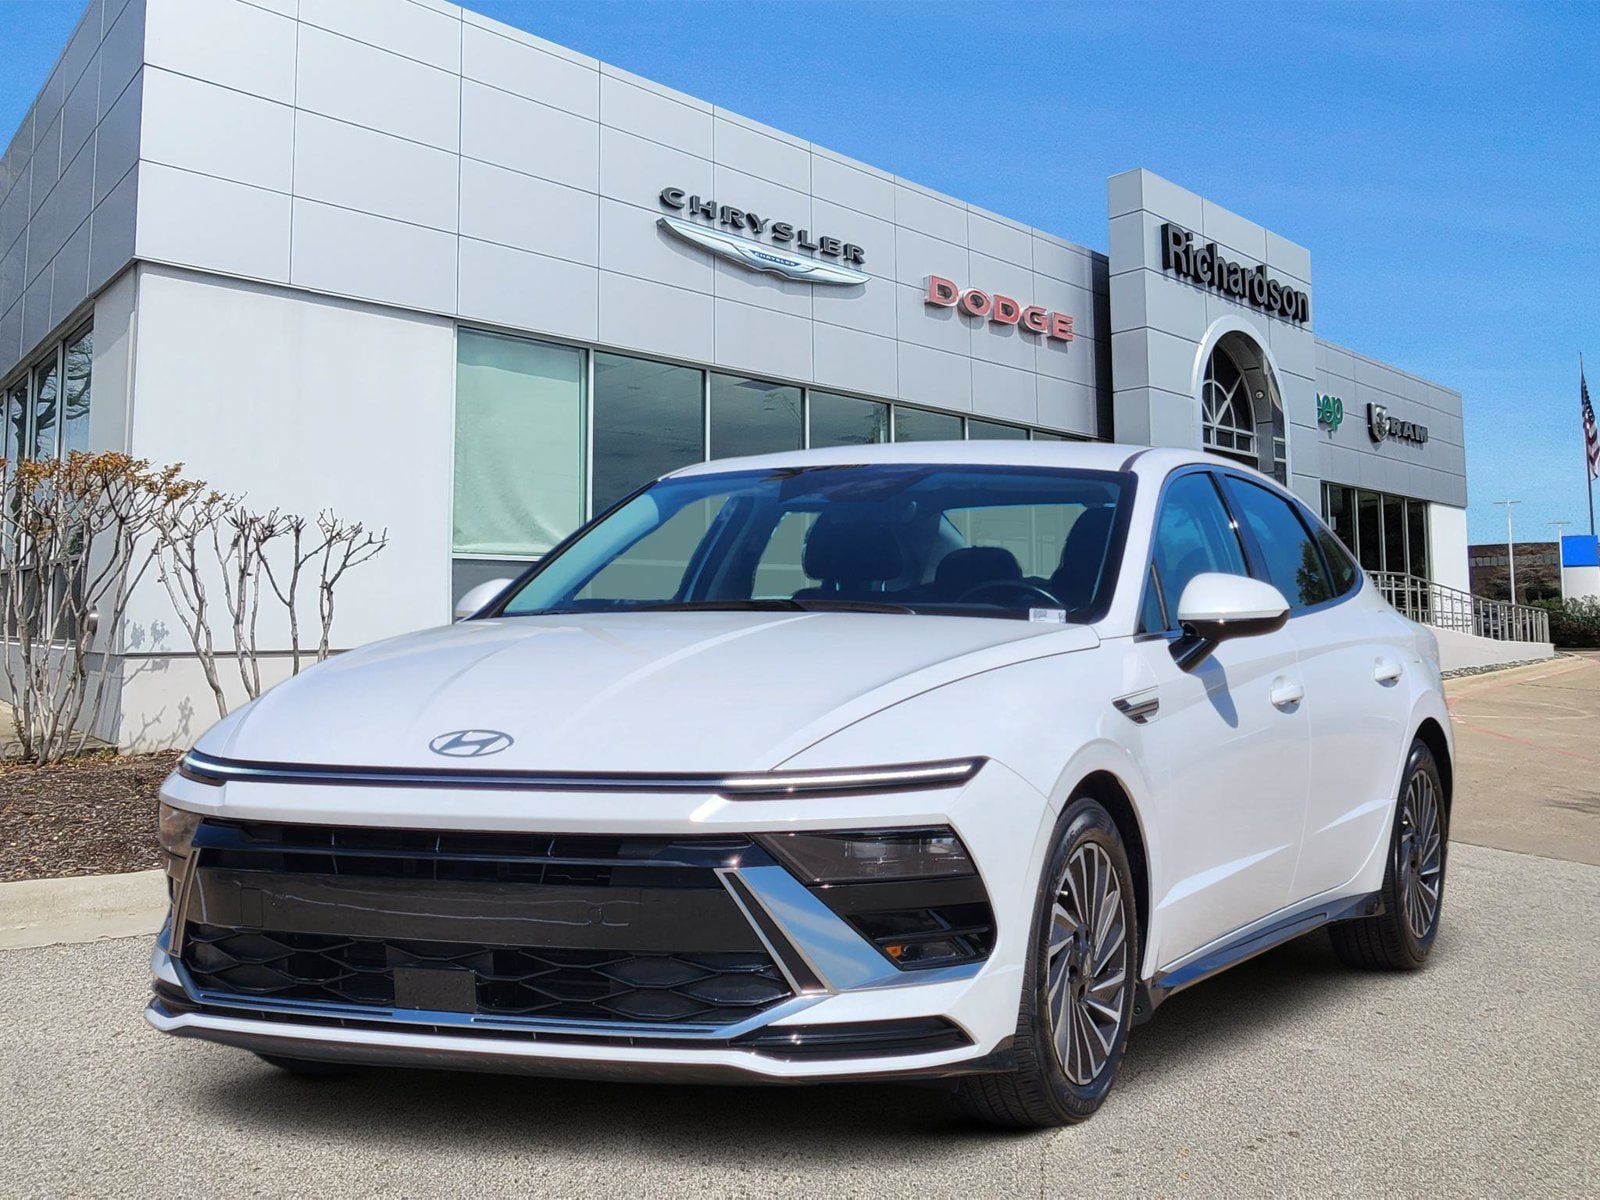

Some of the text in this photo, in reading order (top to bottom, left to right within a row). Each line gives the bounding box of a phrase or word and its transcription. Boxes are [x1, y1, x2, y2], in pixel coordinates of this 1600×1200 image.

[659, 186, 866, 265] CHRYSLER
[924, 274, 1075, 342] DODGE
[1161, 223, 1310, 323] Richardson
[1388, 416, 1428, 443] RAM
